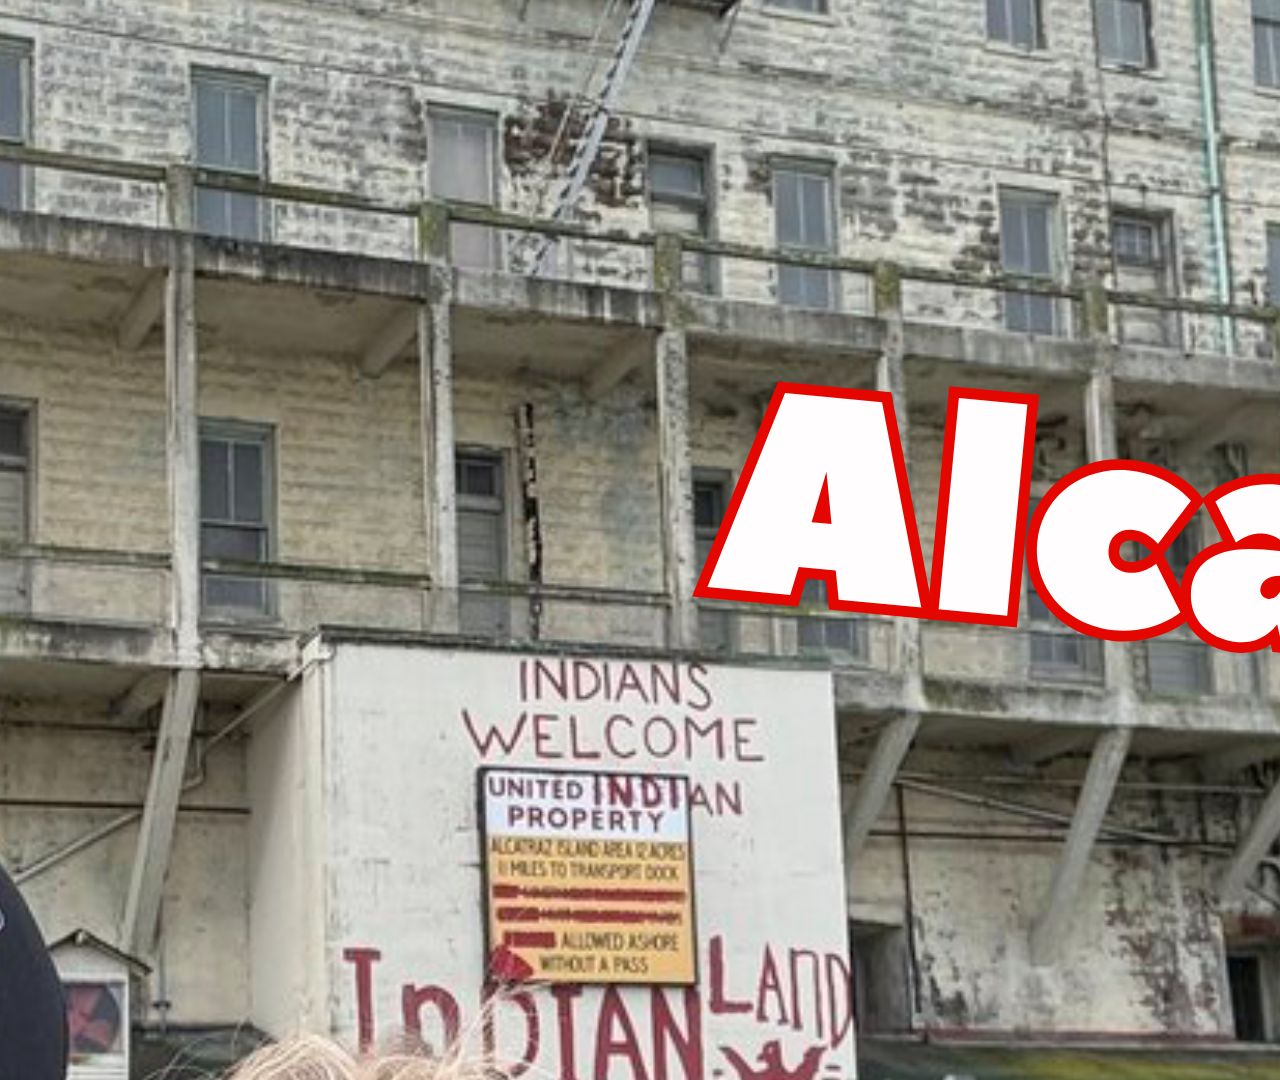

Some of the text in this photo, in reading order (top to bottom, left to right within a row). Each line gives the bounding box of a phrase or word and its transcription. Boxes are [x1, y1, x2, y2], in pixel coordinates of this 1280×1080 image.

[519, 659, 712, 711] INDIANS
[461, 708, 764, 762] WELCOME
[488, 776, 583, 800] UNITED
[507, 805, 664, 832] PROPERTY
[491, 838, 553, 856] ALCATRAZ
[557, 839, 600, 858] ISLAND
[602, 841, 634, 859] AREA
[649, 843, 686, 862] ACRES
[510, 860, 547, 878] MILES
[550, 862, 567, 878] TO
[570, 863, 642, 880] TRANSPORT
[645, 864, 680, 881] DOCK
[560, 931, 622, 950] ALLOWED
[625, 932, 680, 951] ASHORE
[539, 955, 650, 974] WITHOUT A PASS
